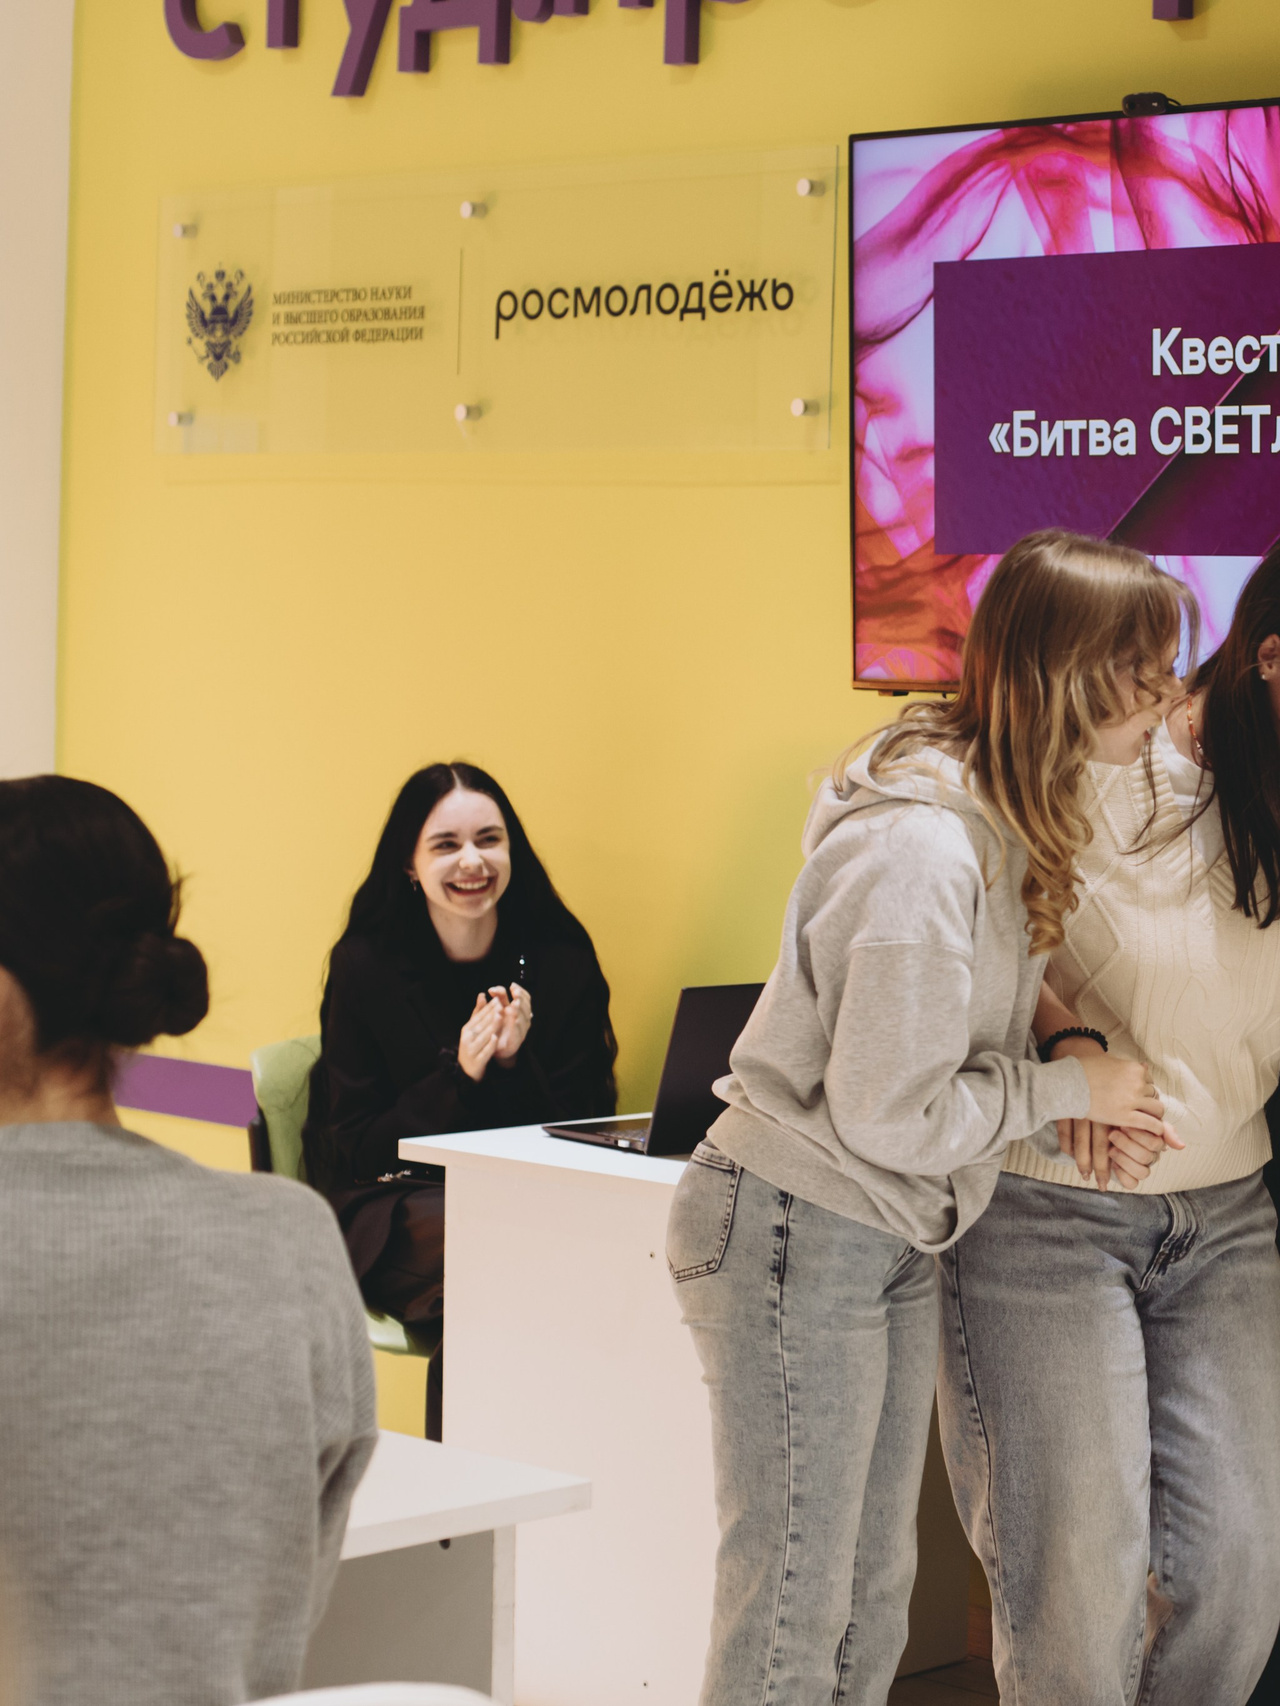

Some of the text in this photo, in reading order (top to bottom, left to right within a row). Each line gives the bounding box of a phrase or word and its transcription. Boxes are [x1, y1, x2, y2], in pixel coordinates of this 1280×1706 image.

[272, 285, 412, 306] МИНИСТЕРСТВО НАУКИ
[495, 269, 794, 340] росмолодёжь
[272, 305, 426, 326] И ВЫСШЕГО ОБРАЗОВАНИЯ
[271, 326, 424, 346] РОССИЙСКОЙ ФЕДЕРАЦИИ
[988, 409, 1137, 457] «Битва
